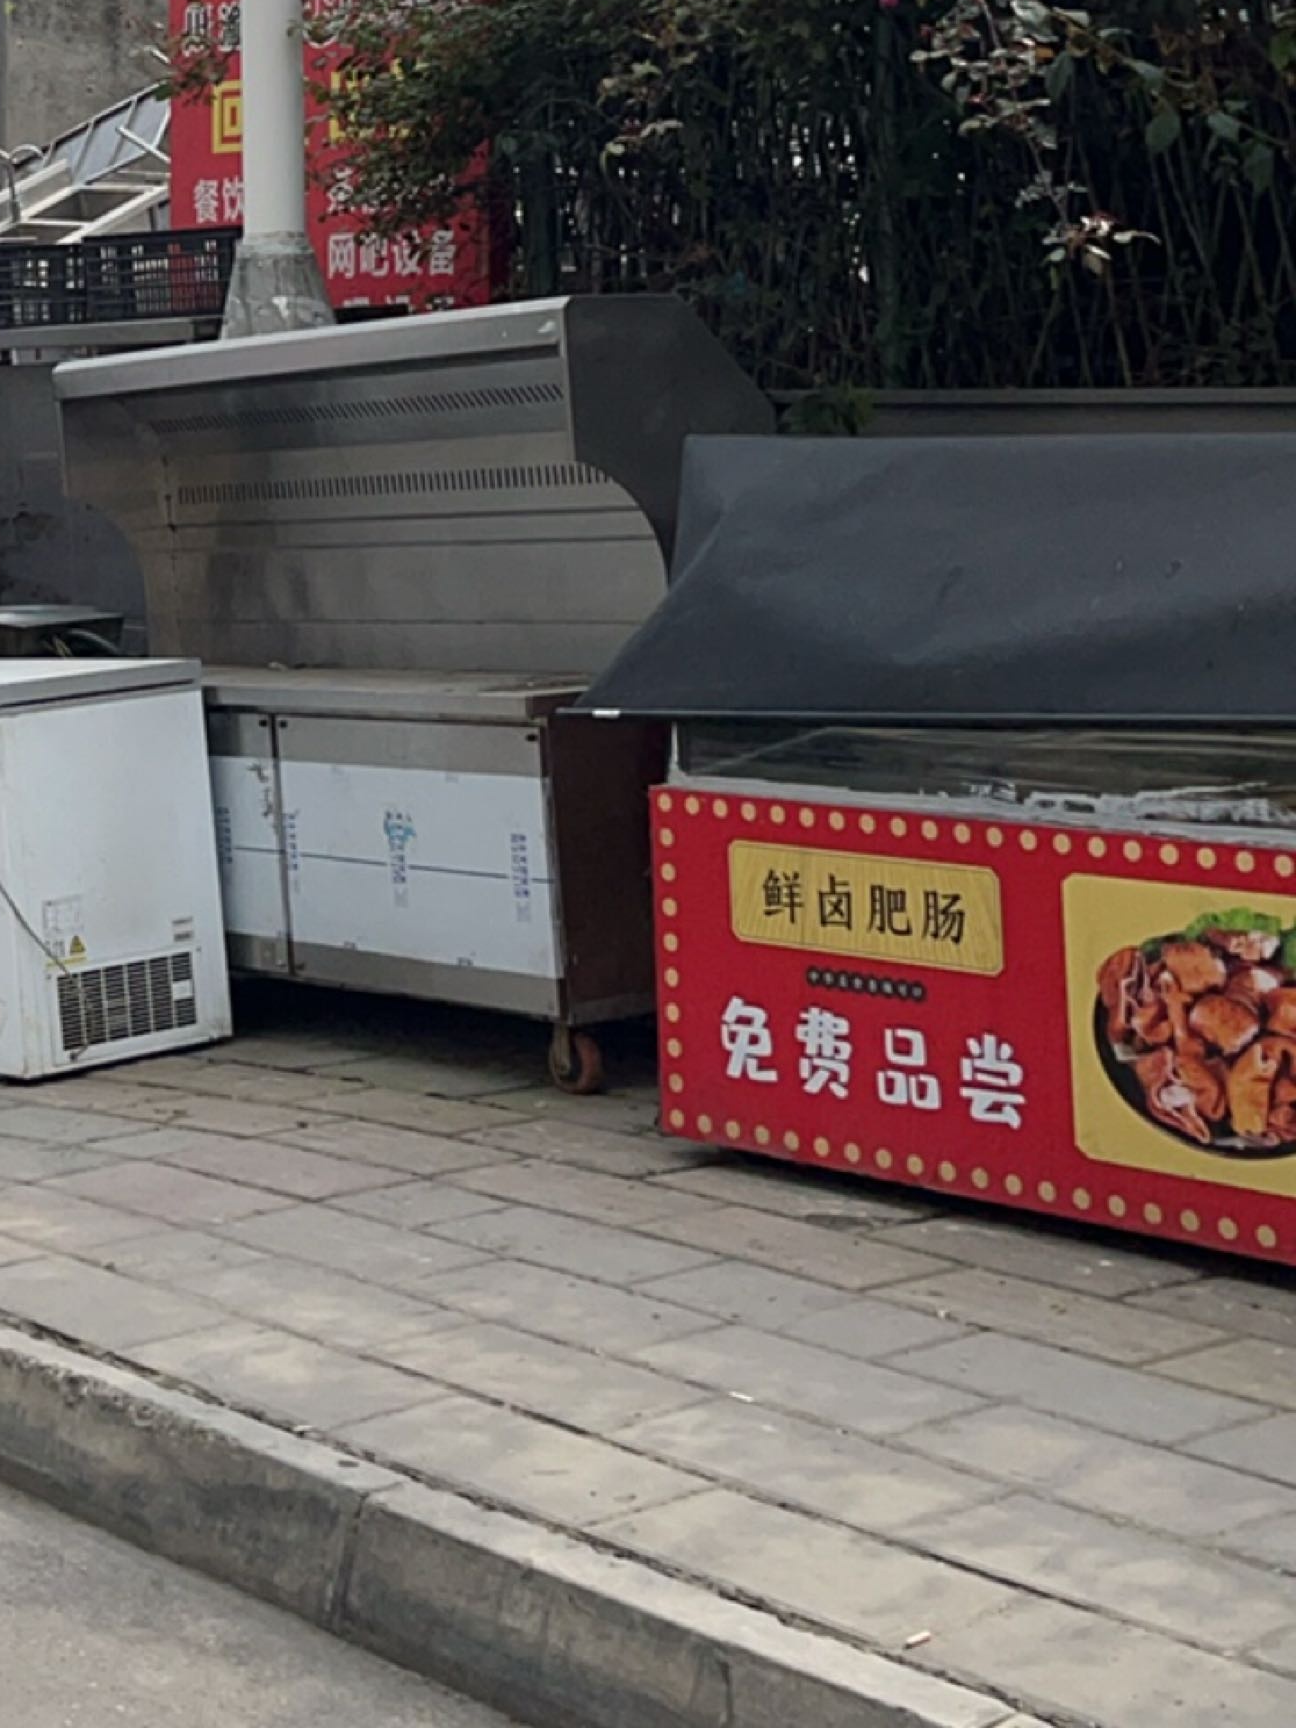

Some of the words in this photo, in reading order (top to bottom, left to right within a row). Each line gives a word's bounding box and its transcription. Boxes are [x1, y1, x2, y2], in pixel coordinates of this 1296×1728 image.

[762, 869, 966, 945] 鲜卤肥肠
[720, 995, 1027, 1130] 免费品尝
